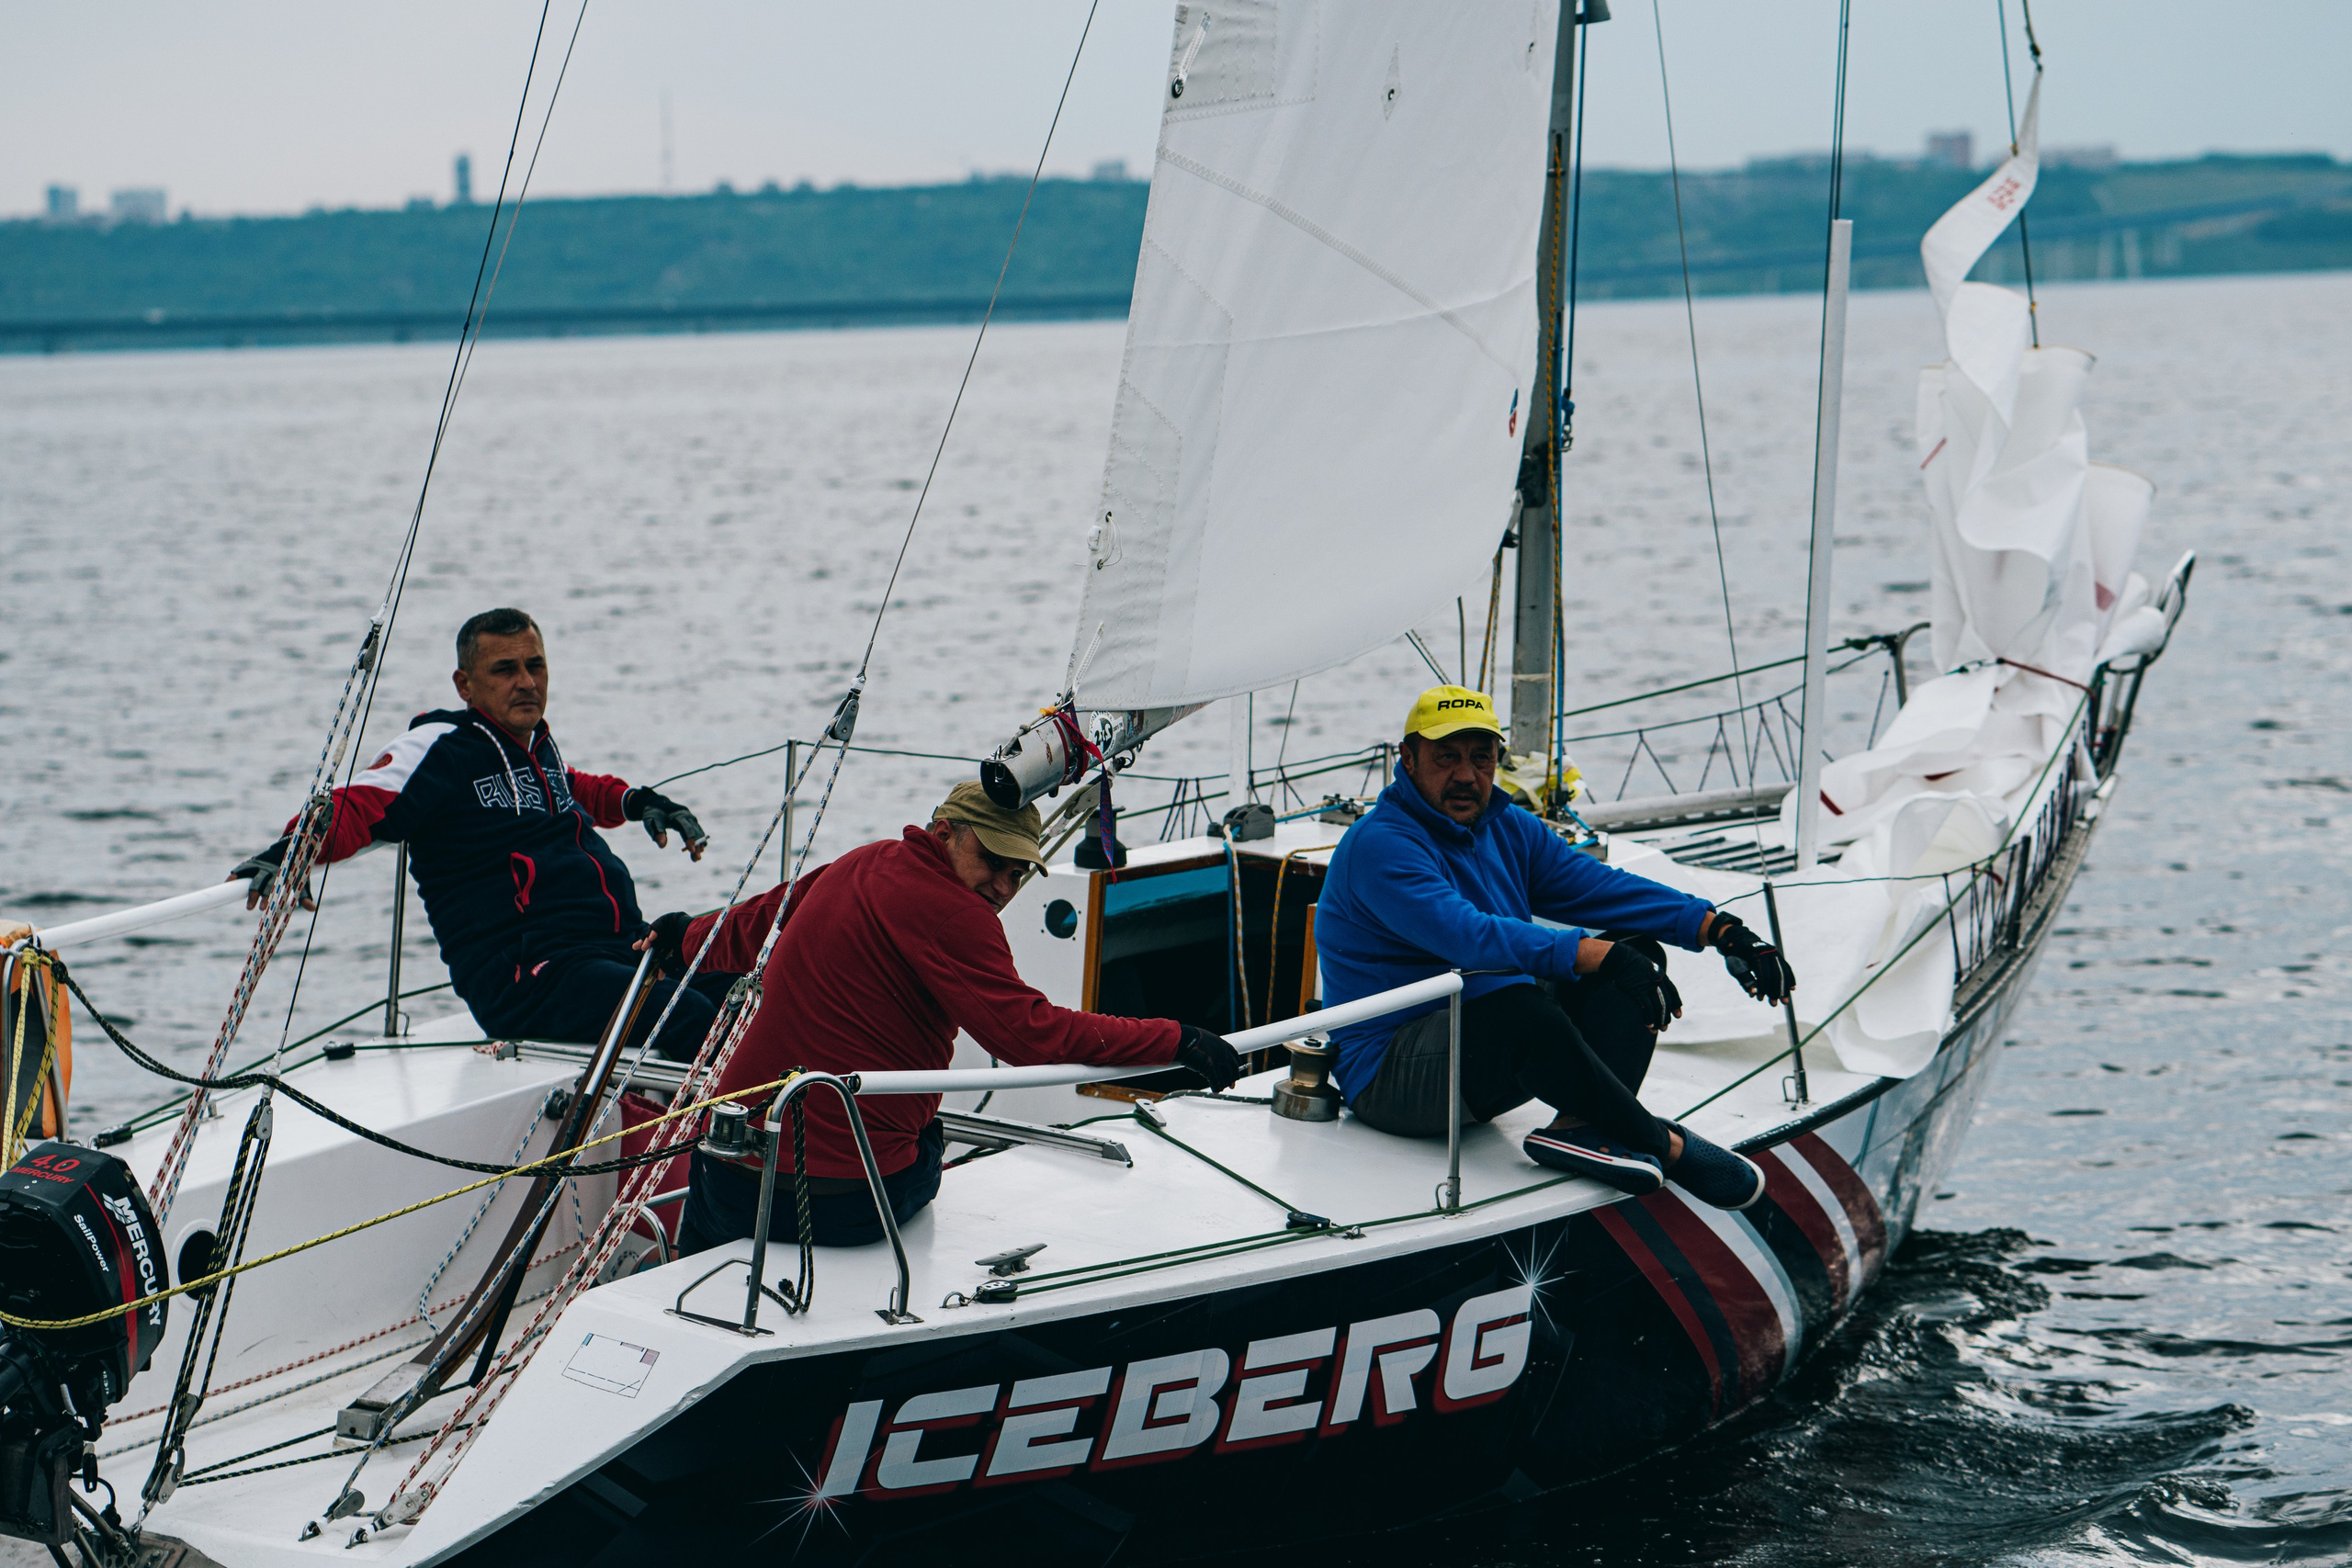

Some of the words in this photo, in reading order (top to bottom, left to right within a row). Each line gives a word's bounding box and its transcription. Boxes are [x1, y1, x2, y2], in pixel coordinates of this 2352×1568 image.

[1437, 699, 1485, 712] ROPA
[9, 1166, 75, 1184] MERCURY
[30, 1154, 81, 1172] 4.0
[74, 1213, 109, 1272] SailPower
[112, 1196, 161, 1325] MERCURY
[820, 1285, 1533, 1497] ICEBERG
